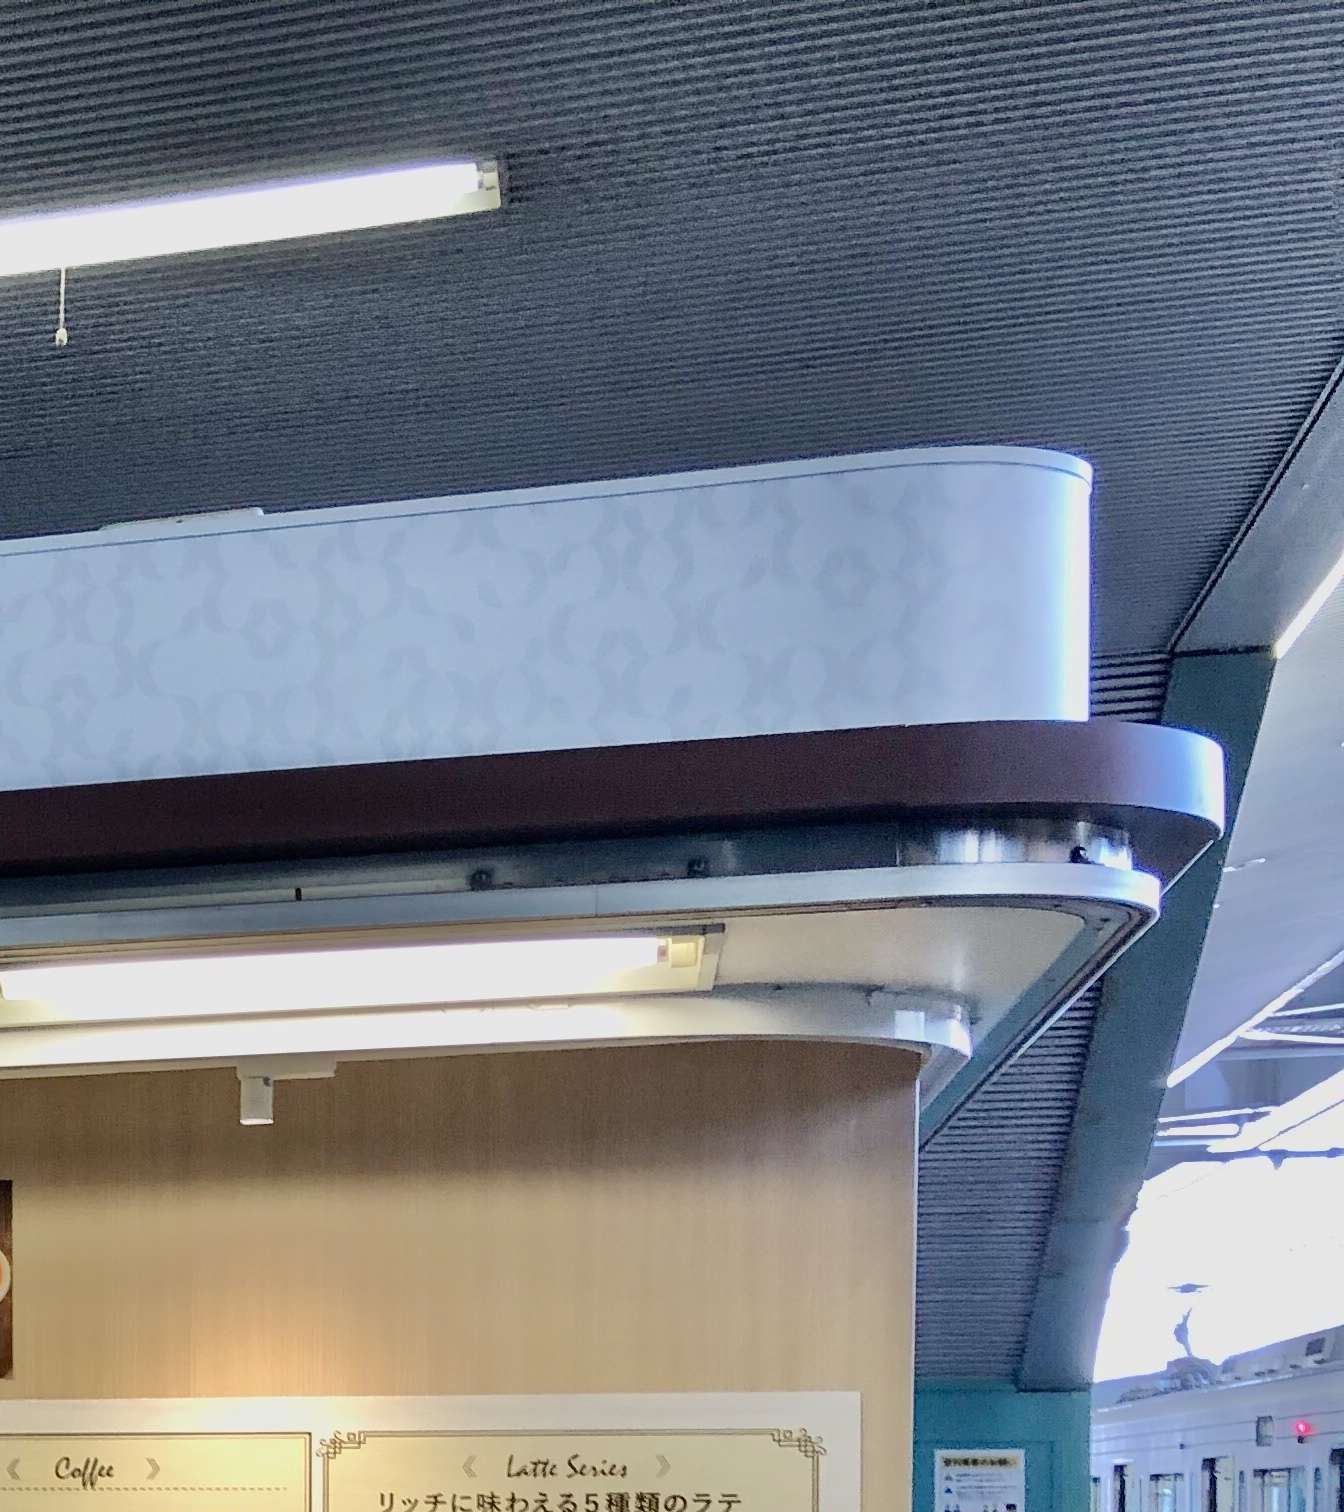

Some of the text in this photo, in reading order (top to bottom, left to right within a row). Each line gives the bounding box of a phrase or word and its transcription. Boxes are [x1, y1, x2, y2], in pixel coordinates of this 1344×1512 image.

[54, 1457, 115, 1490] Coffee
[506, 1454, 629, 1480] Latte Series
